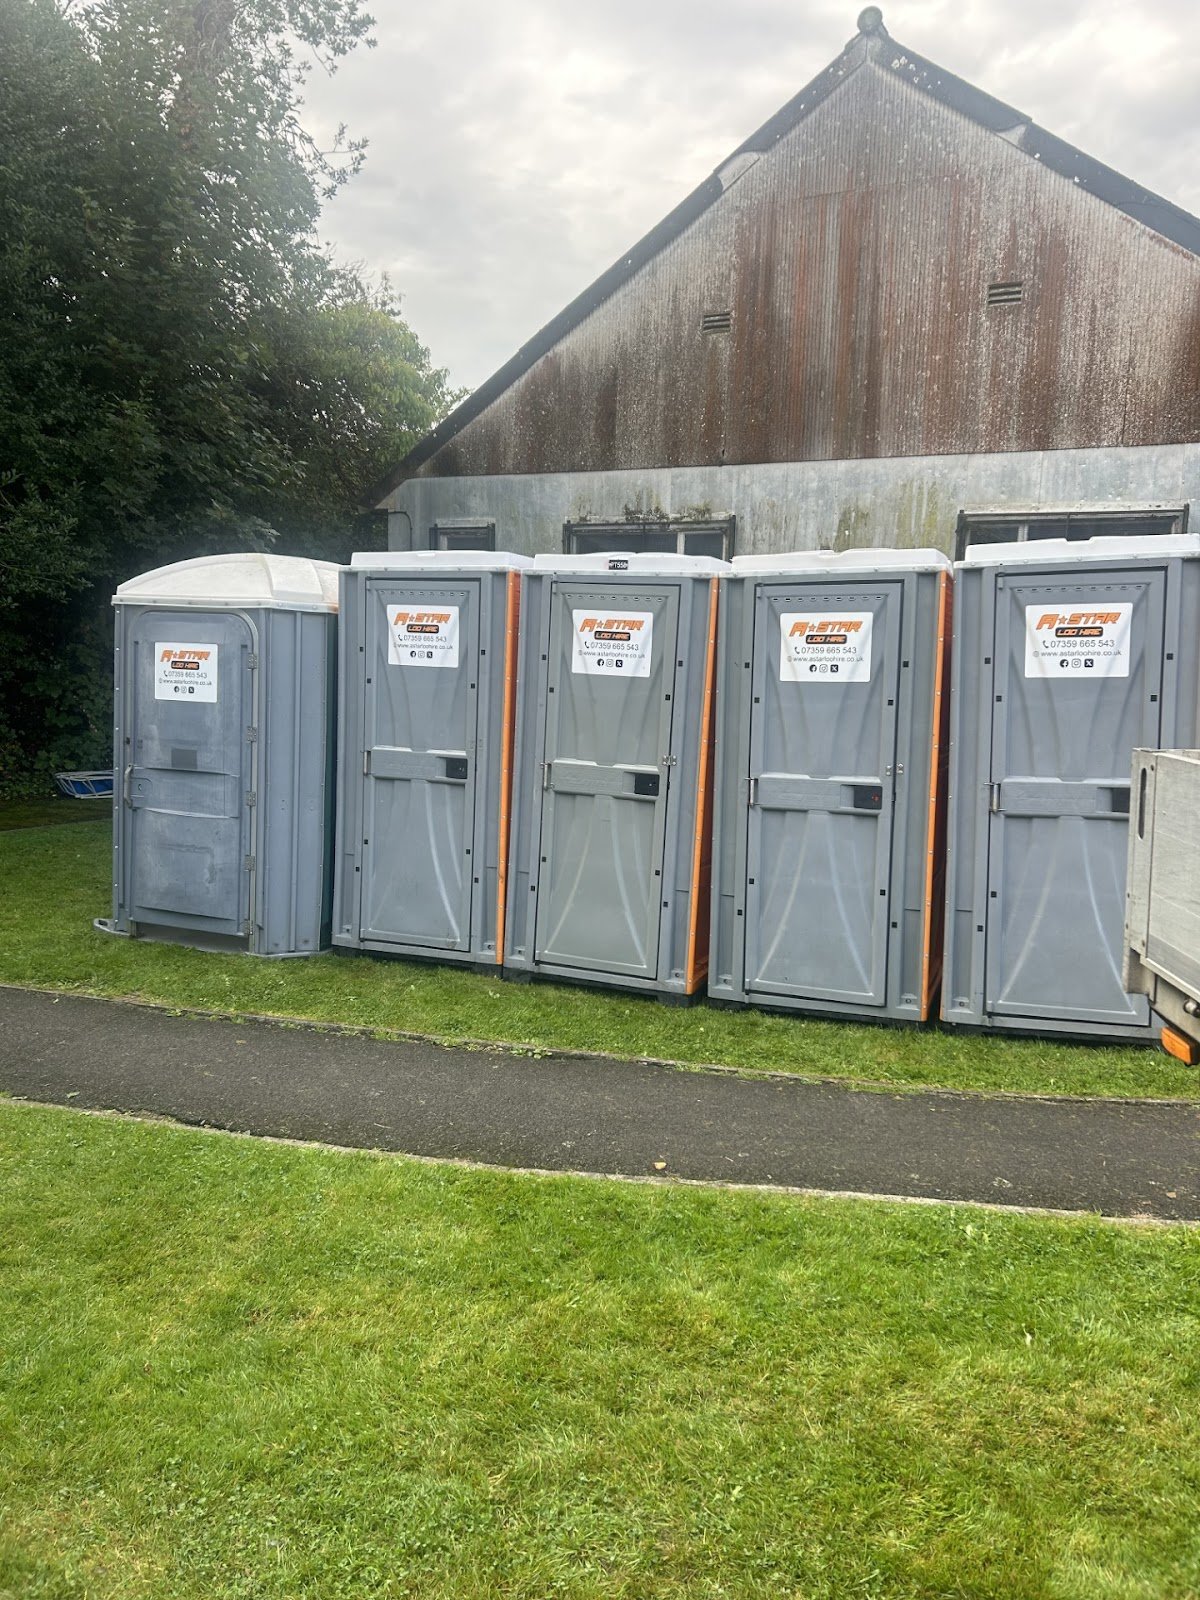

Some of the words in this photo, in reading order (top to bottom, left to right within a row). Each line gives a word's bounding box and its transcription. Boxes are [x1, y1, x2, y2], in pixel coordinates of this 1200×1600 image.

[590, 642, 611, 650] 07359
[612, 642, 625, 650] 665
[1050, 640, 1078, 648] 07359
[1079, 640, 1096, 648] 665
[1098, 639, 1115, 648] 543
